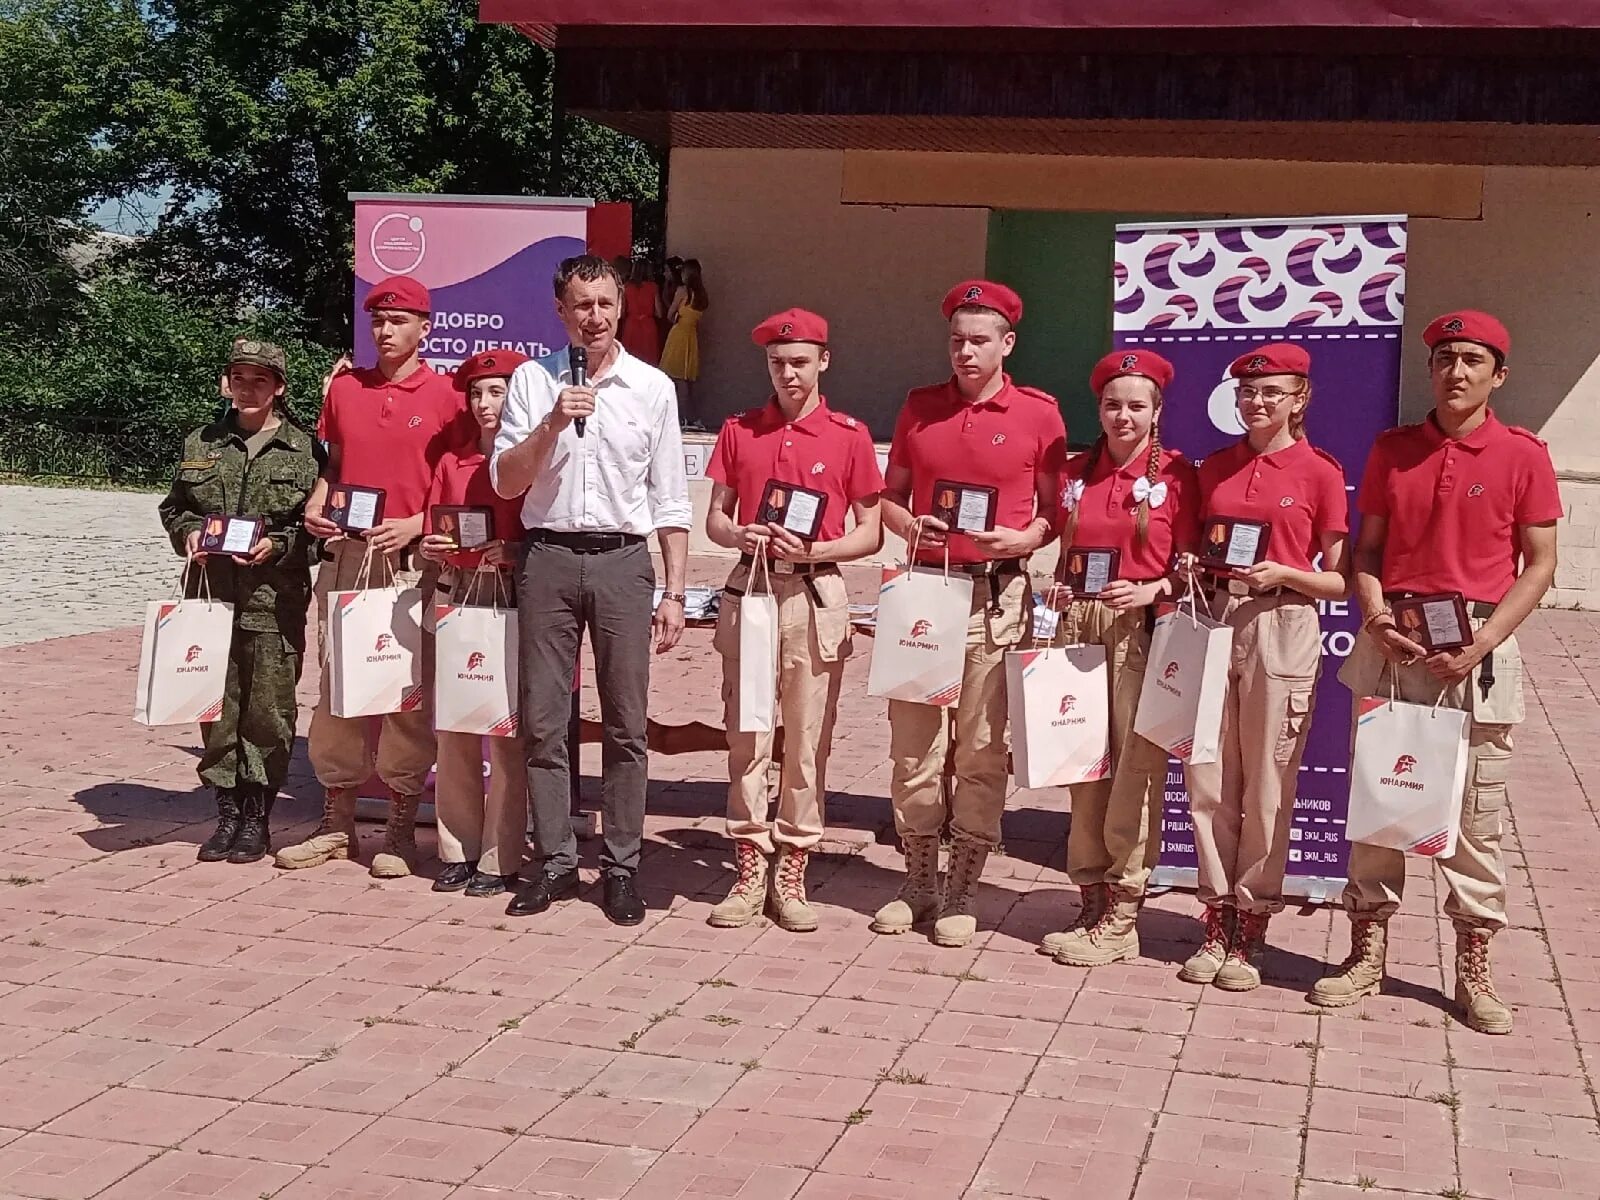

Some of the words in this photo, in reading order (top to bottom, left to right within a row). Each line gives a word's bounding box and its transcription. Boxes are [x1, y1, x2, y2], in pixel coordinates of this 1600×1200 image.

[433, 311, 504, 330] ДОБРО
[1379, 777, 1425, 791] ЮНАРМИЯ
[1164, 791, 1190, 803] ОССИ
